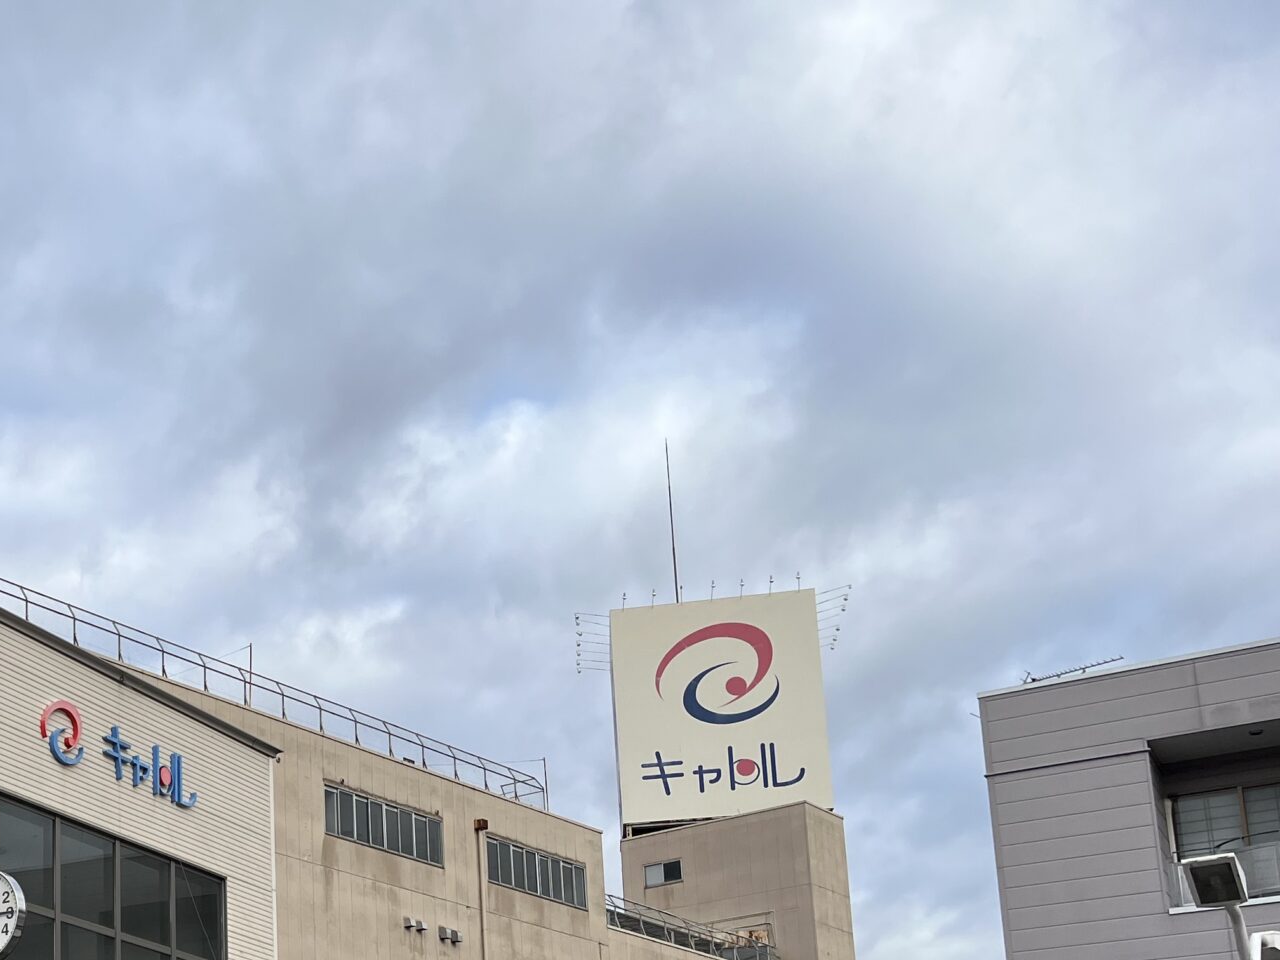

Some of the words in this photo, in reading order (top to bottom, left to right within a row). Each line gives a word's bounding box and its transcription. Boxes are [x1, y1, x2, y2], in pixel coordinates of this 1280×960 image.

[102, 724, 198, 809] キャトル
[641, 742, 805, 796] キャトル
[2, 891, 10, 904] 2
[6, 906, 14, 919] 3
[1, 923, 9, 935] 4
